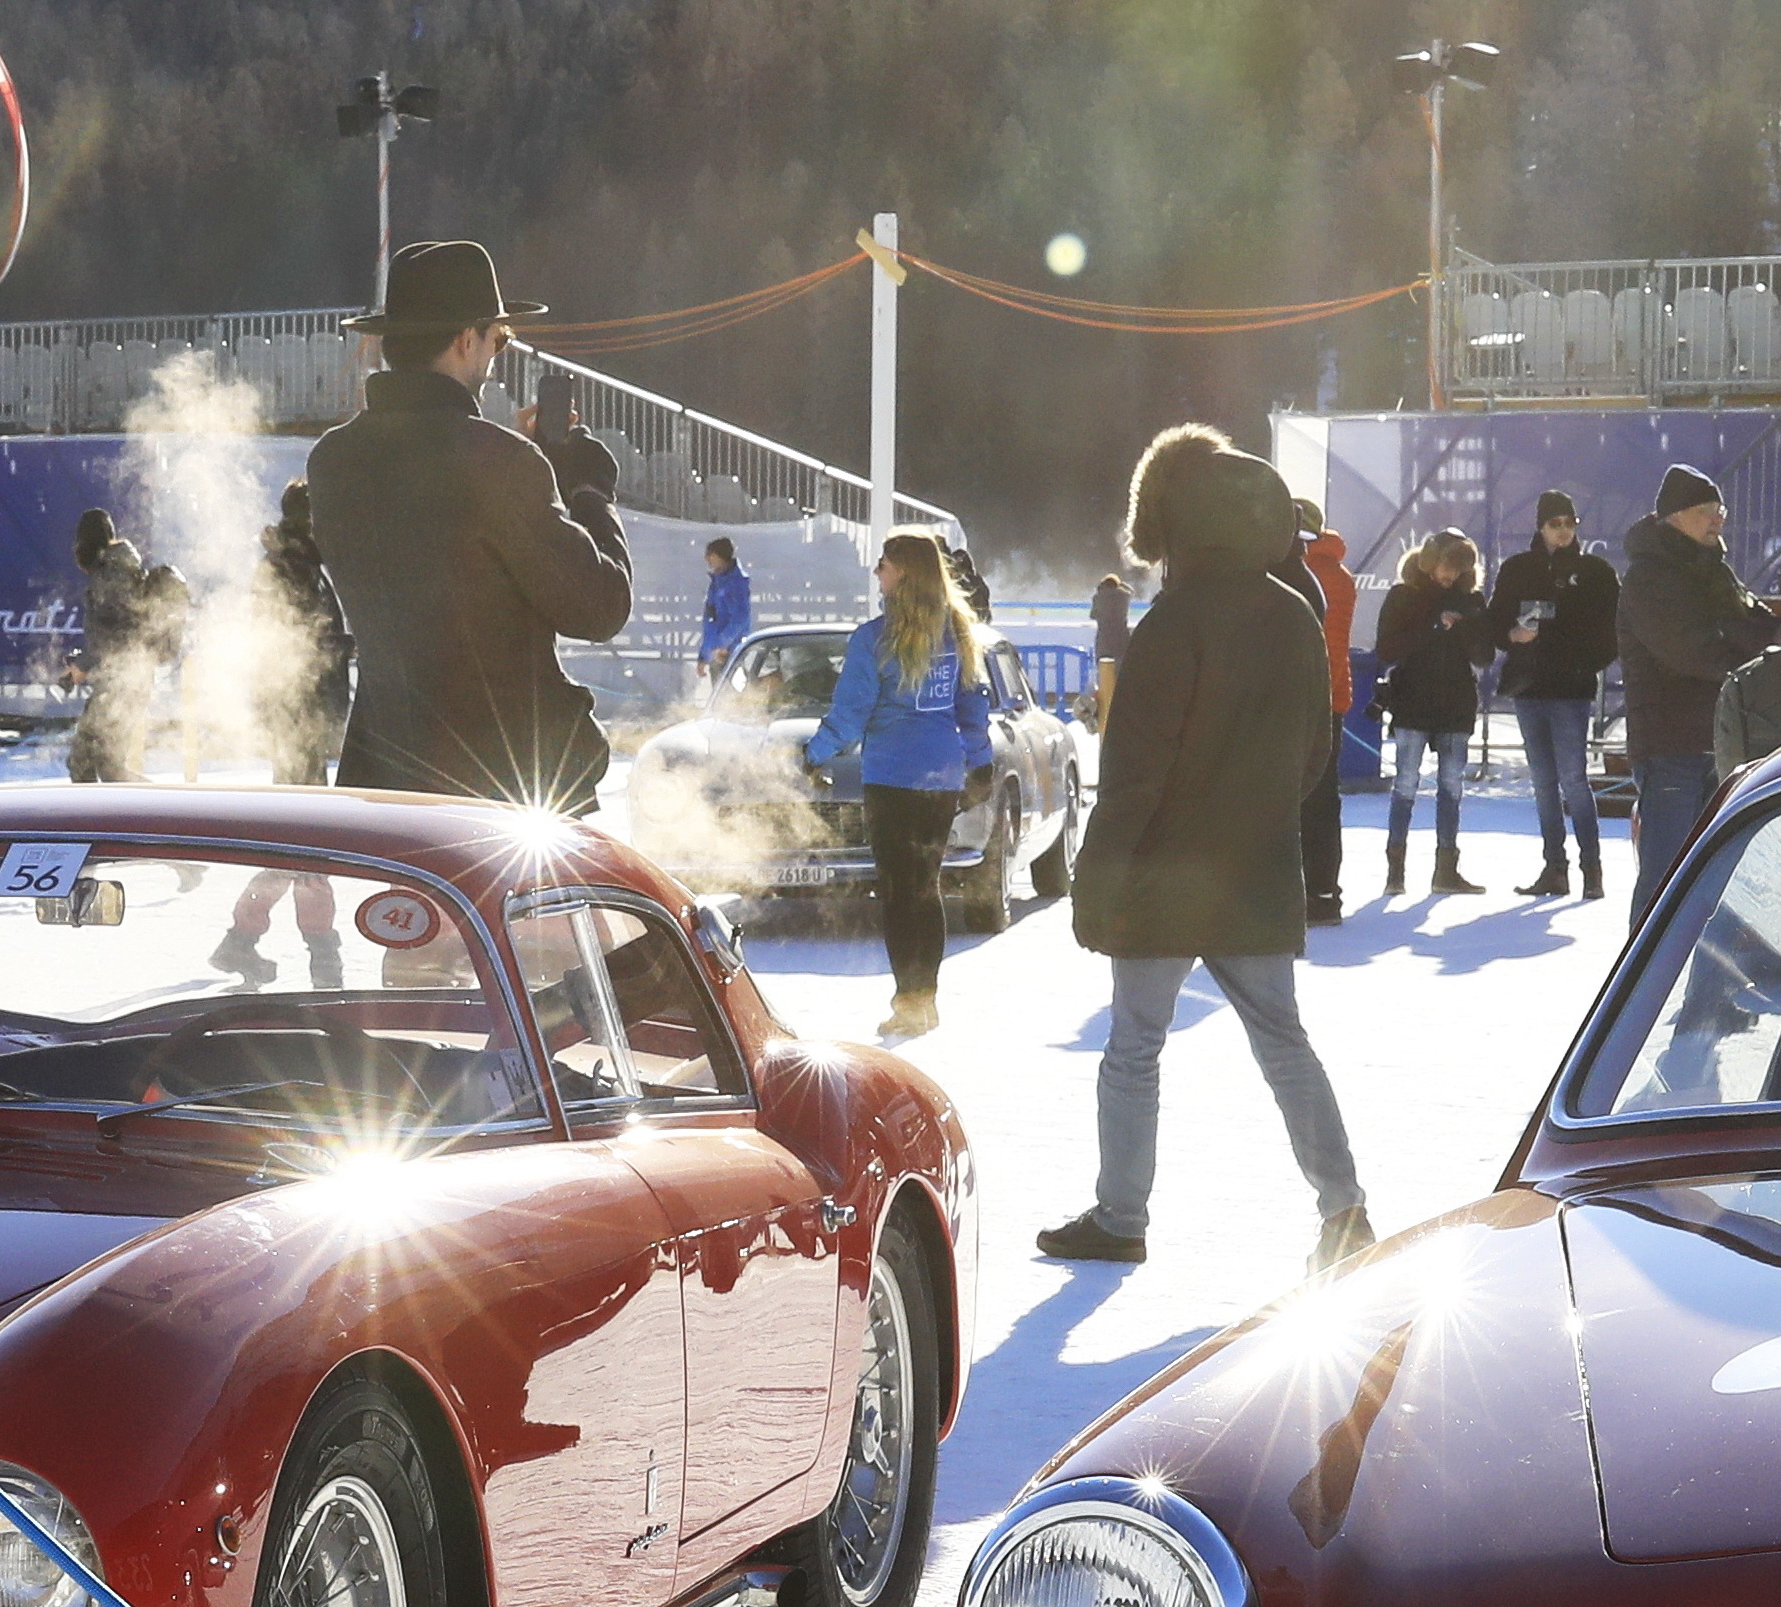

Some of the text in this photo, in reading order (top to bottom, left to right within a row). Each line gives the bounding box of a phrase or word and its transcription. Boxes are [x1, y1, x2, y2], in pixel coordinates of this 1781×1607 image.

[929, 682, 950, 698] ICE
[5, 864, 64, 893] 56
[777, 867, 810, 884] 2618
[381, 907, 414, 930] 41
